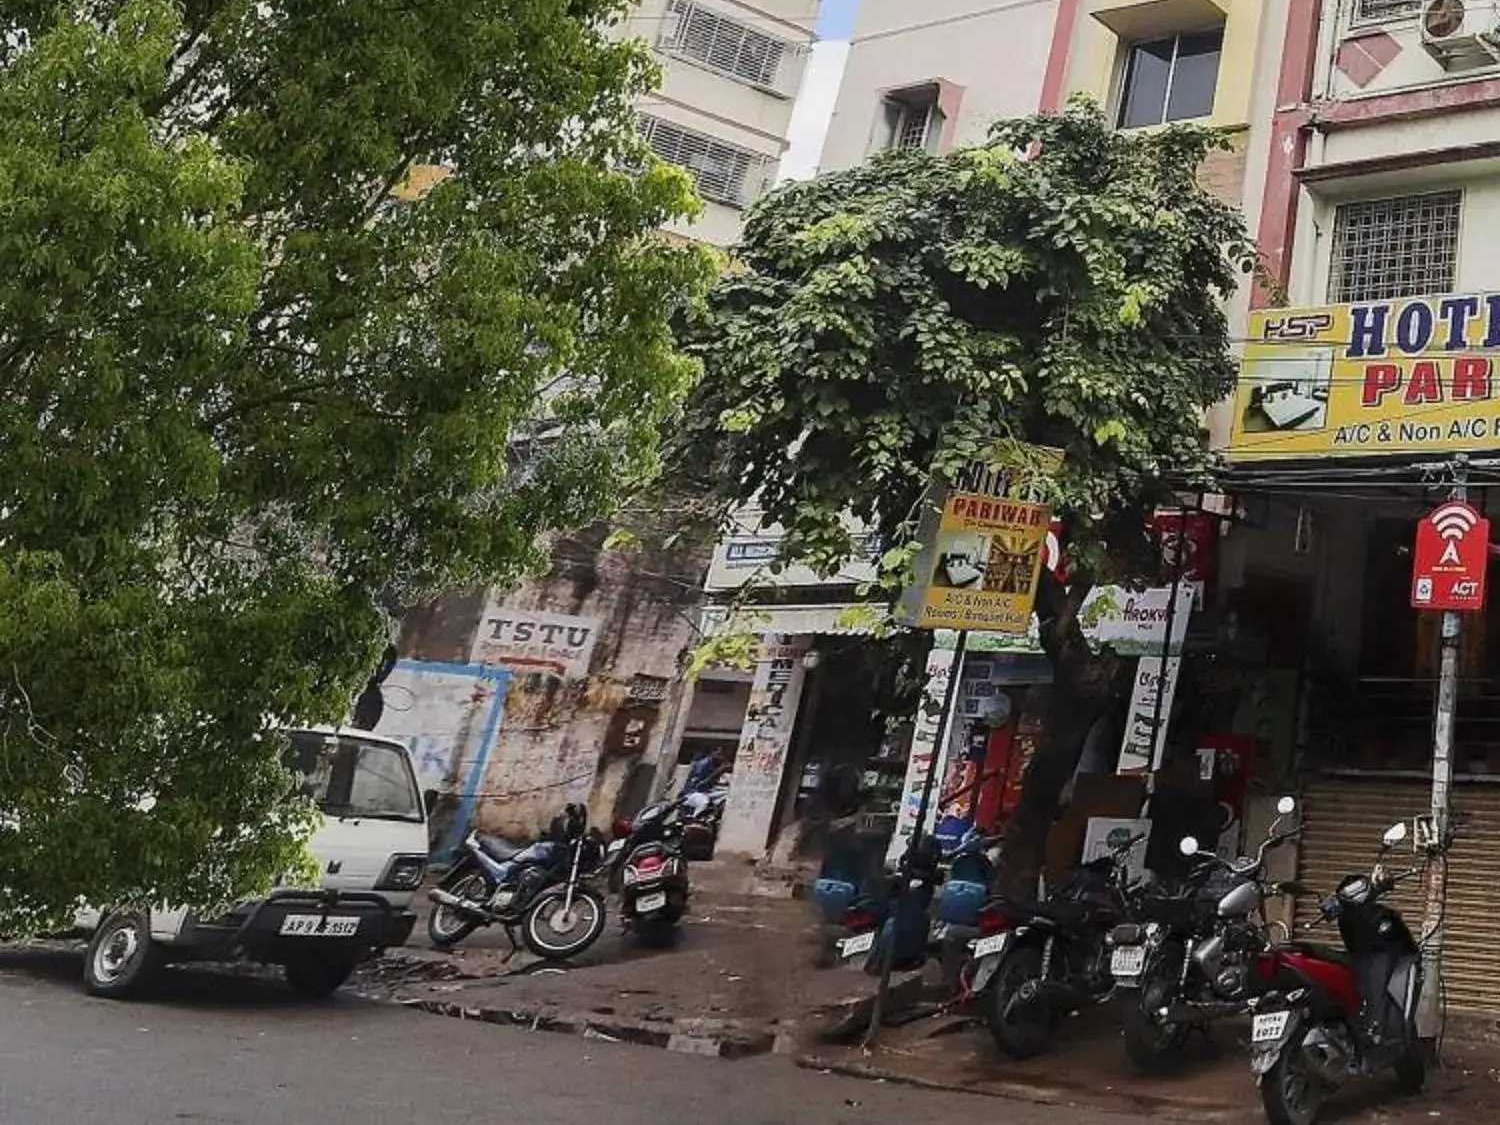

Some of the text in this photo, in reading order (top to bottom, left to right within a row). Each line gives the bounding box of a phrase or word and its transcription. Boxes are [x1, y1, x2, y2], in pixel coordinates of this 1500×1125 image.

[1334, 424, 1371, 444] A/C
[1376, 425, 1392, 442] &
[1399, 424, 1440, 442] Non
[1447, 418, 1487, 439] A/C
[487, 617, 592, 648] TSTU
